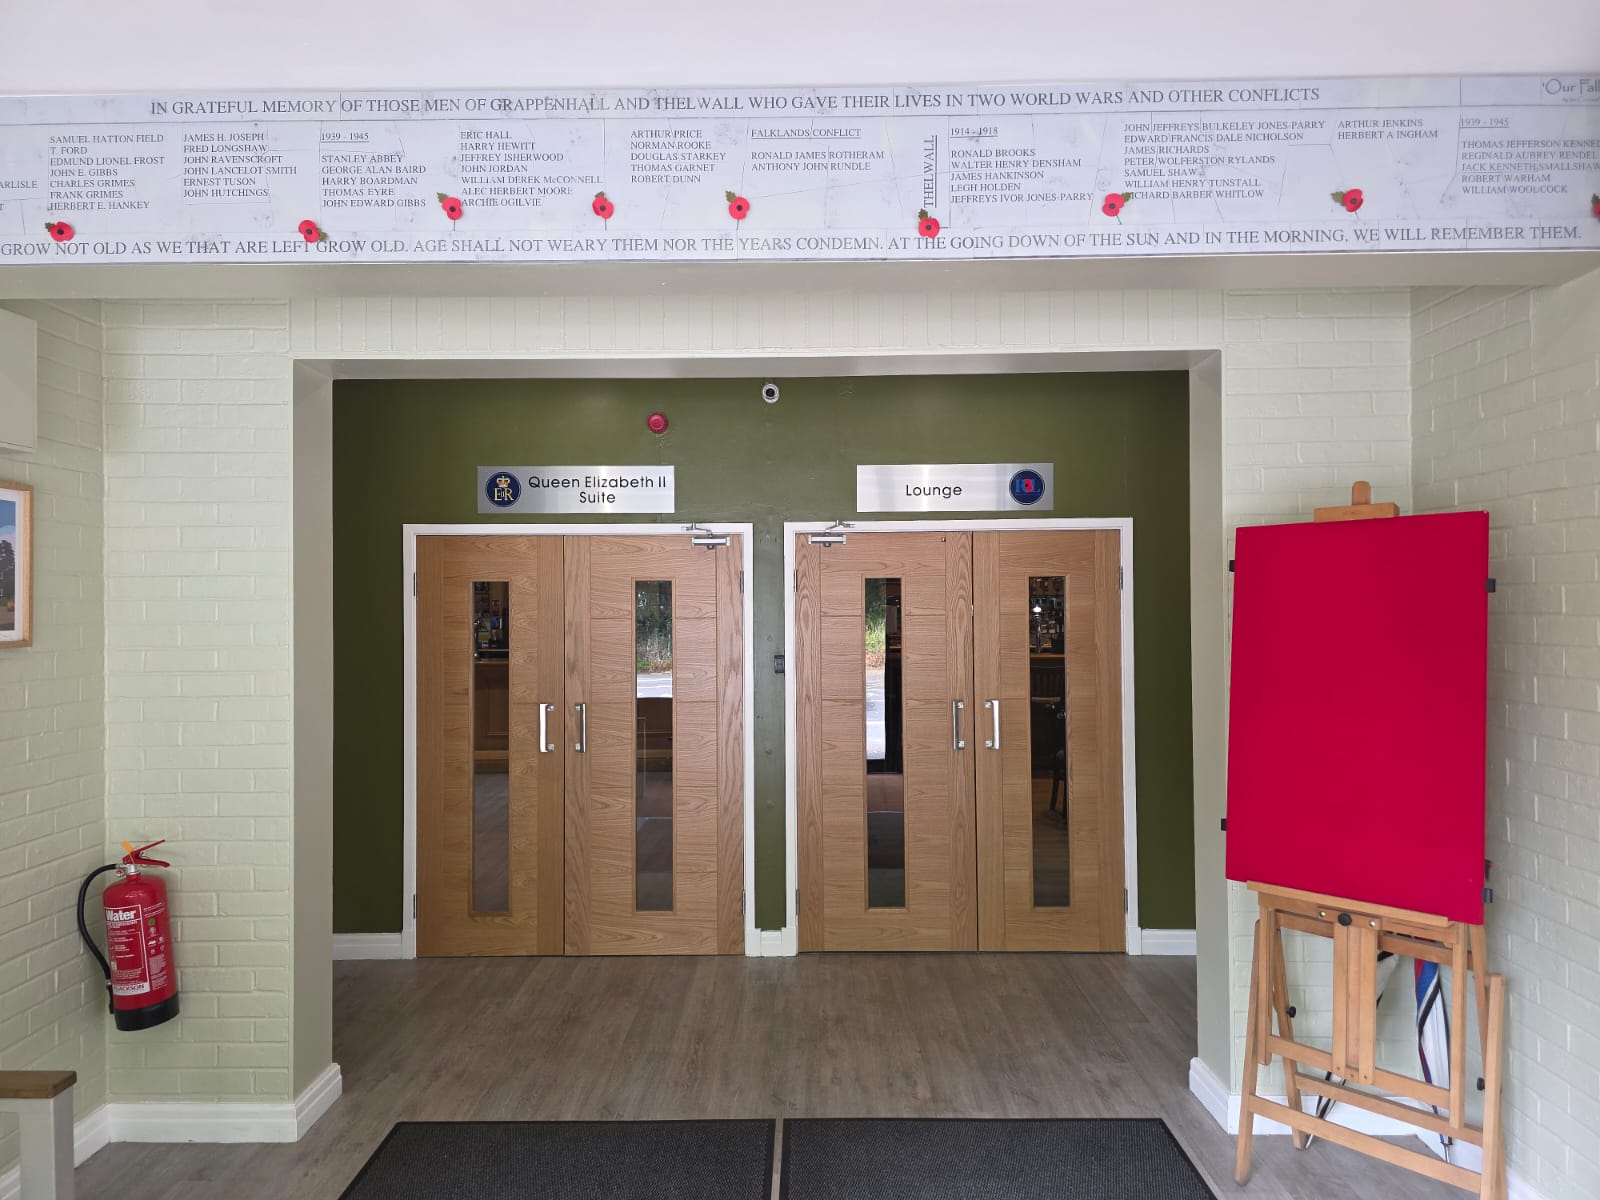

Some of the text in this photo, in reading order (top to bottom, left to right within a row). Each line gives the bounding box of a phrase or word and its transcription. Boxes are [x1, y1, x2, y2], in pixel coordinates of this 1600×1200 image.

[151, 88, 1320, 115] IN GRATEFUL MEMORY OF THOSE MEN OF GRAPPENHALL AND THELWALL WHO GAVE THEIR LIVES IN TWO WORLD WARS AND OTHER CONFLICTS
[1124, 124, 1149, 132] JOHN
[1153, 123, 1199, 131] JEFFREYS
[1202, 122, 1255, 130] BULKELEY
[1338, 119, 1423, 128] ARTHUR JENKINS
[184, 133, 264, 142] JAMES H. JOSEPH
[460, 131, 511, 139] ERIC HALL
[631, 130, 702, 138] ARTHUR PRICE
[752, 129, 810, 137] FALKLANDS
[1124, 132, 1303, 143] EDWARD FRANCIS DALE NICHOLSON
[50, 136, 91, 144] SAMUEL
[93, 135, 133, 143] HATTON
[184, 144, 268, 153] FRED LONGSHAW
[460, 142, 535, 150] HARRY HEWITT
[1159, 146, 1209, 154] RICHARDS
[461, 153, 563, 162] JEFFREY ISHERWOOD
[682, 152, 726, 160] STARKEY
[752, 151, 884, 160] RONALD JAMES ROTHERAM
[952, 149, 1036, 158] RONALD BROOKS
[50, 156, 164, 166] EDMUND LIONEL FROST
[184, 156, 208, 164] JOHN
[321, 154, 403, 163] STANLEY ABBEY
[460, 164, 527, 173] JOHN JORDAN
[632, 164, 672, 172] THOMAS
[952, 159, 1081, 169] WALTER HENRY DENSHAM
[184, 166, 297, 175] JOHN LANCELOT SMITH
[322, 165, 426, 174] GEORGE ALAN BAIRD
[924, 136, 934, 208] THELWALL
[1124, 168, 1196, 177] SAMUEL SHAW
[322, 176, 417, 185] HARRY BOARDMAN
[951, 171, 1044, 181] JAMES HANKINSON
[1462, 174, 1550, 182] ROBERT WARHAM
[50, 180, 94, 188] CHARLES
[184, 178, 255, 186] ERNEST TUSON
[368, 188, 395, 196] EYRE
[952, 183, 1020, 192] LEGH HOLDEN
[1462, 185, 1568, 194] WILLIAM WOODCOCK
[50, 191, 124, 199] FRANK GRIMES
[184, 189, 268, 198] JOHN HUTCHINGS
[350, 199, 394, 207] EDWARD
[396, 199, 425, 207] GIBBS
[952, 195, 996, 203] JEFFREYS
[999, 194, 1025, 202] IVOR
[1, 226, 1582, 256] GROW NOT OLD AS WE THAT ARE LEFT GROW OLD. AGE SHALL NOT WEARY THEM NOR THE YEARS CONDEMN. AT THE GOING DOWN OF THE SUN AND IN THE MORNING, WE WILL REMEMBER THEM.
[528, 476, 666, 488] Queen Elizabeth II
[906, 484, 962, 498] Lounge
[579, 491, 616, 503] Suite
[106, 910, 136, 921] Water
